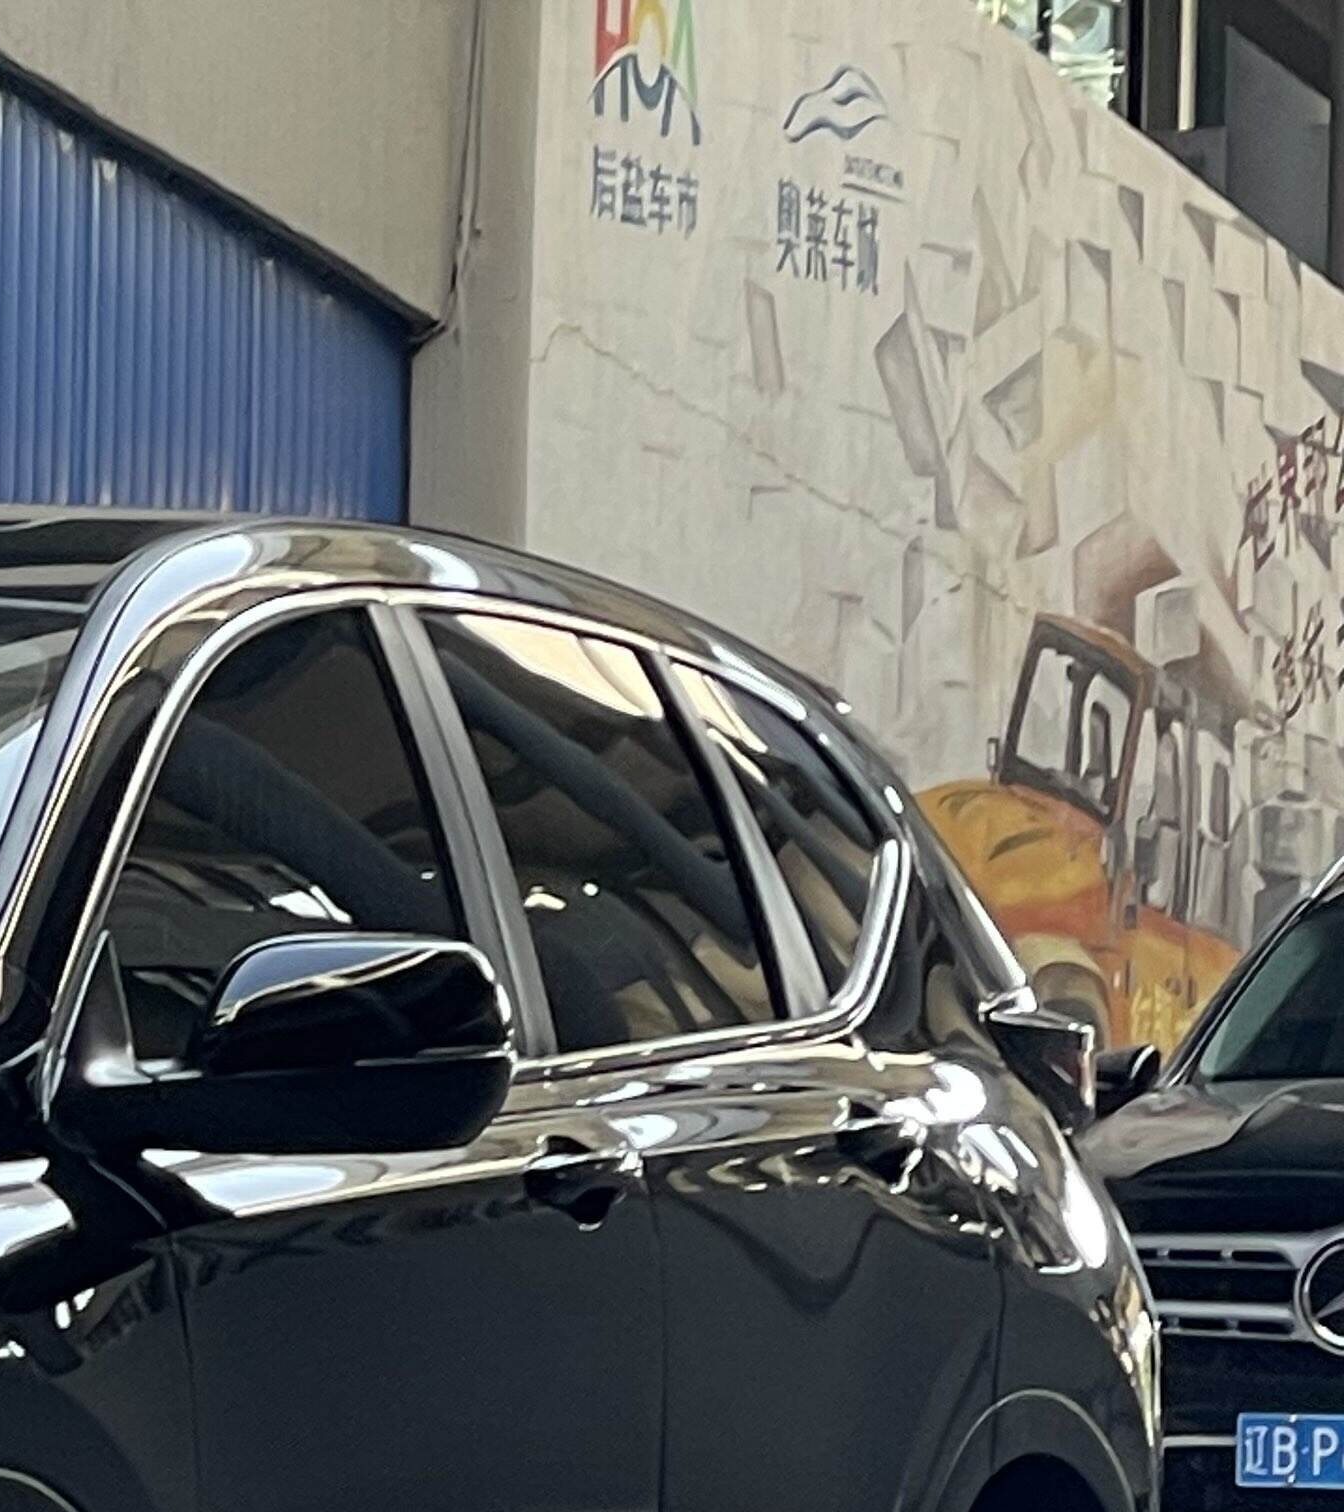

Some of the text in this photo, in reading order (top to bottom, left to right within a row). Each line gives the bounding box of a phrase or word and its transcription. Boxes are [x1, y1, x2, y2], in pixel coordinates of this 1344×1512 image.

[590, 145, 699, 240] 后盐车市
[1244, 1425, 1344, 1476] 辽B·P
